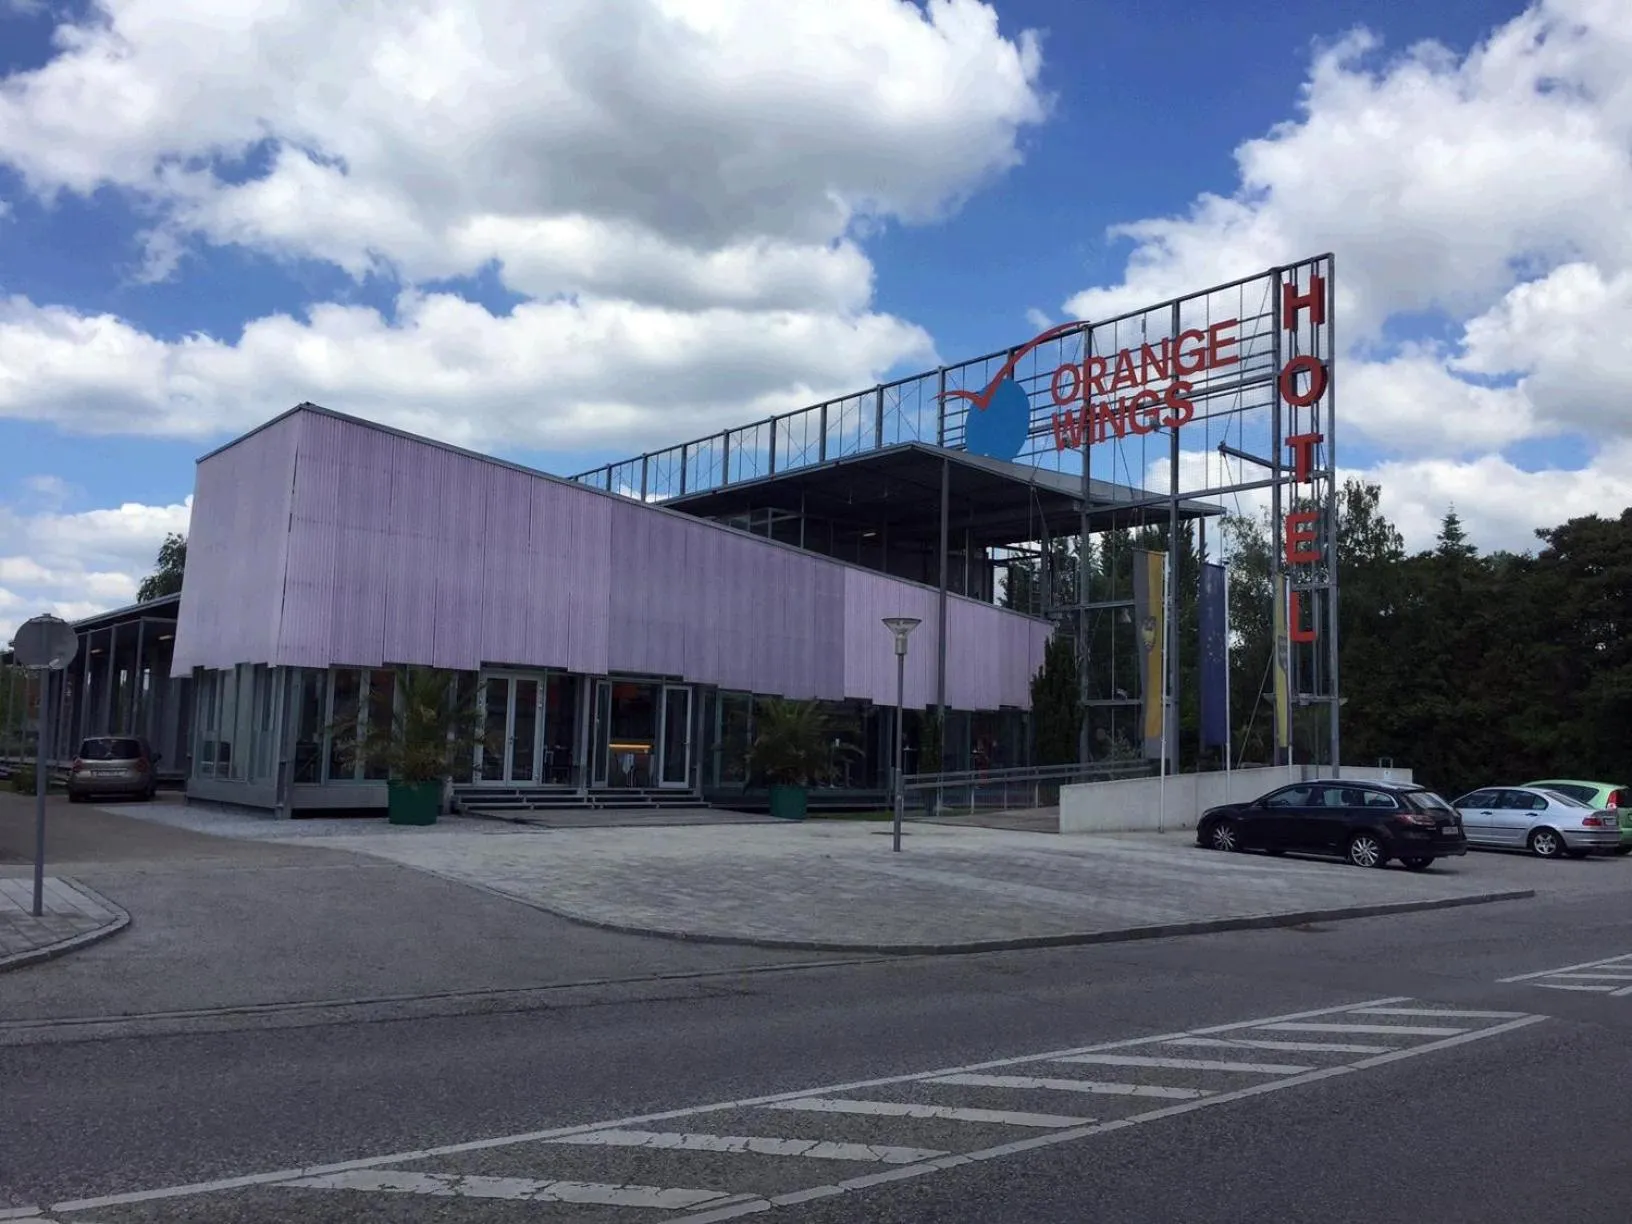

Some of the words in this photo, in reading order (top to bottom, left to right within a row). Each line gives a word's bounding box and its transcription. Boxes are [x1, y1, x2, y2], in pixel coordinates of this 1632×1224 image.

[1052, 319, 1239, 405] ORANGE
[1052, 382, 1194, 450] WINGS
[1280, 275, 1328, 642] HOTEL
